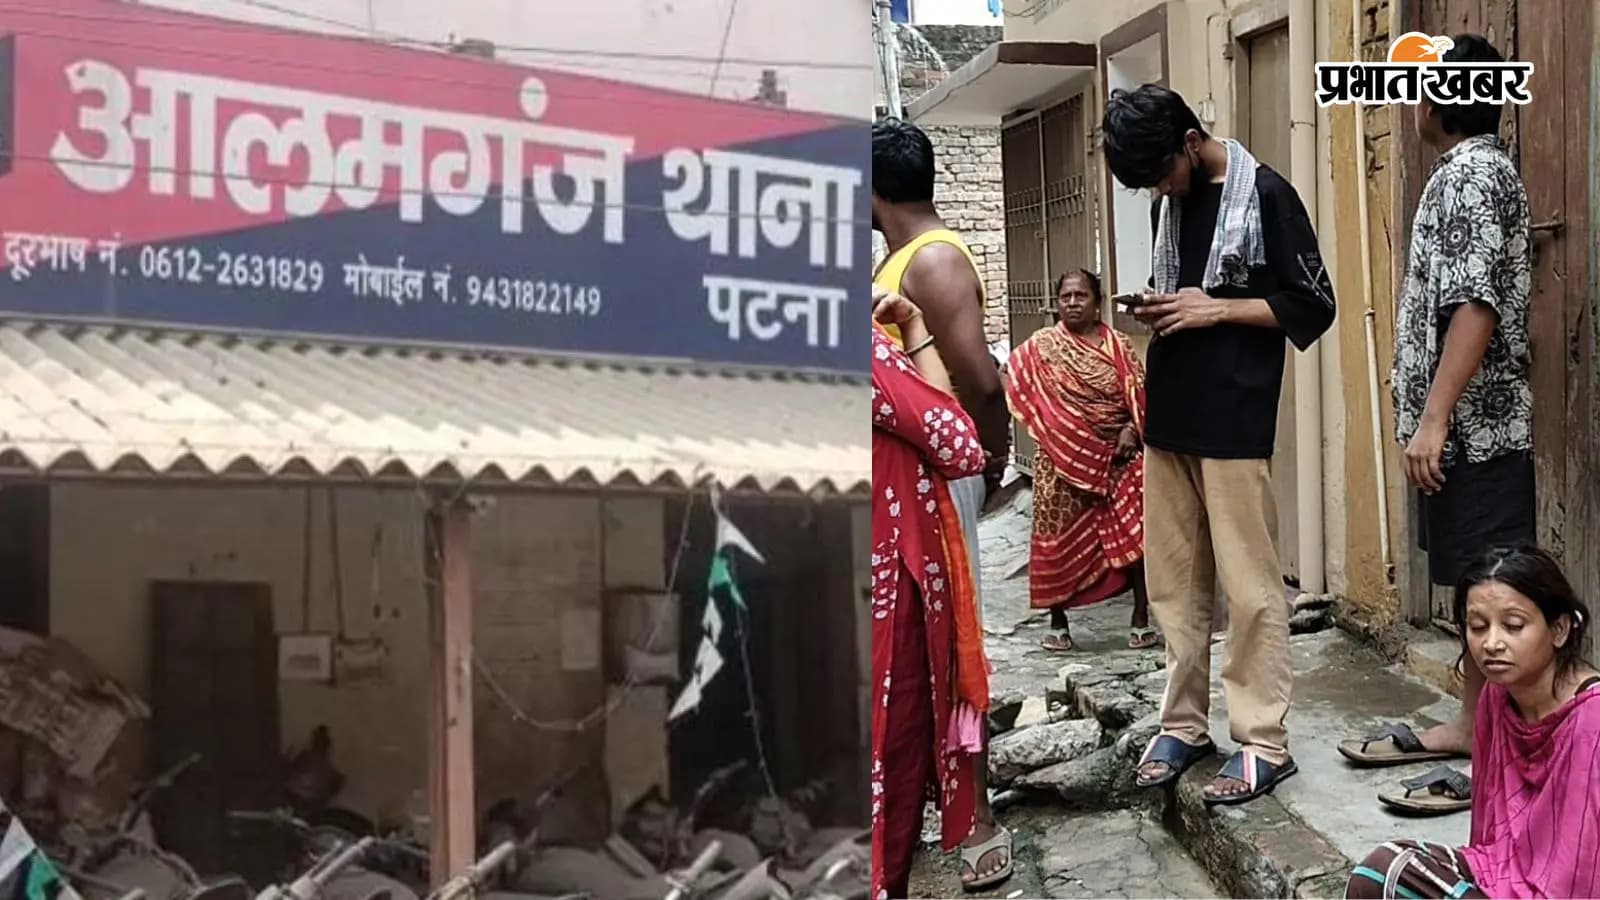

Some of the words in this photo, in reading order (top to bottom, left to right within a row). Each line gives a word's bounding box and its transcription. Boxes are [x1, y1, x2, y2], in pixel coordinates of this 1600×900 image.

[49, 58, 635, 244] आलमगंज
[662, 146, 862, 270] थाना
[3, 231, 91, 282] दूरभाष
[139, 245, 325, 293] 0612-2631829
[343, 254, 425, 305] मोबाईल
[466, 275, 601, 317] 9431822149
[702, 273, 848, 348] पटना
